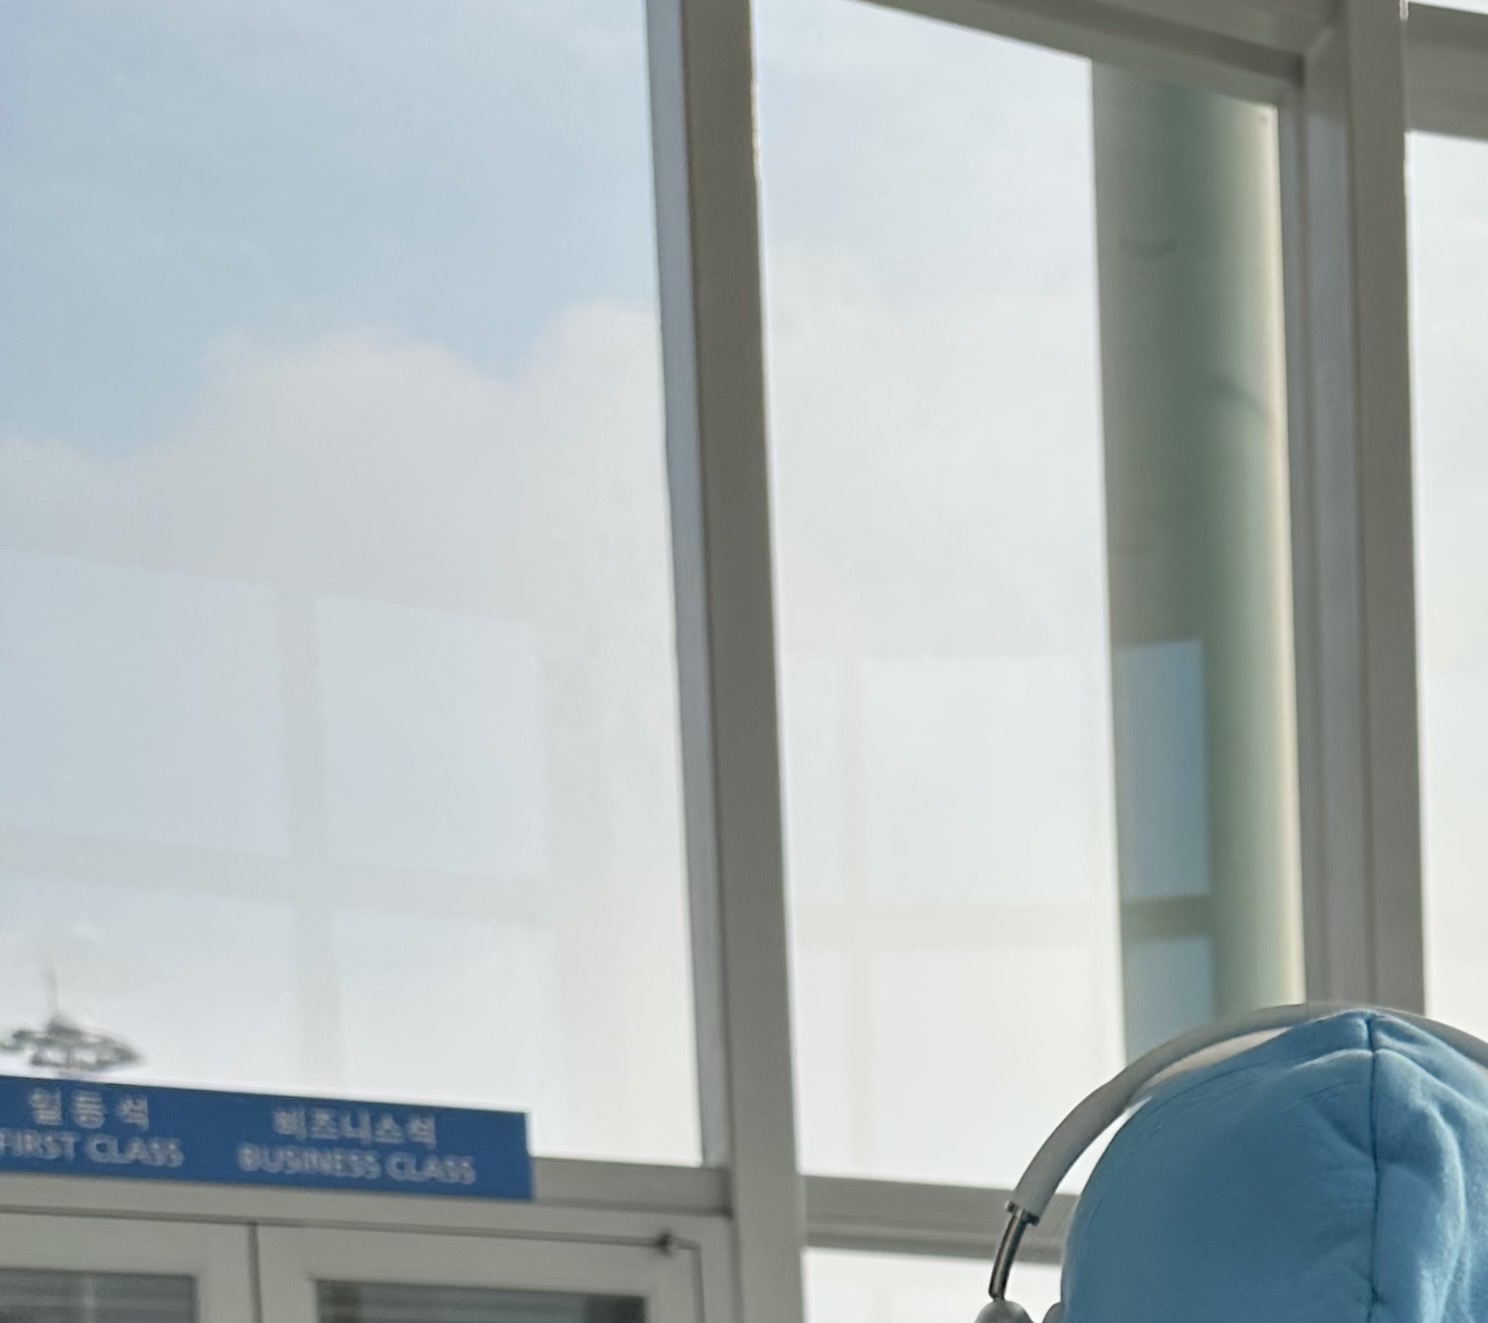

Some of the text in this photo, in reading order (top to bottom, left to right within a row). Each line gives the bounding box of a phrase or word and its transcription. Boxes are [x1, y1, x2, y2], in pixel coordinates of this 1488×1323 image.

[272, 1105, 437, 1150] 비즈니스석
[87, 1132, 185, 1168] CLASS
[235, 1142, 476, 1185] BUSINESS CLASS
